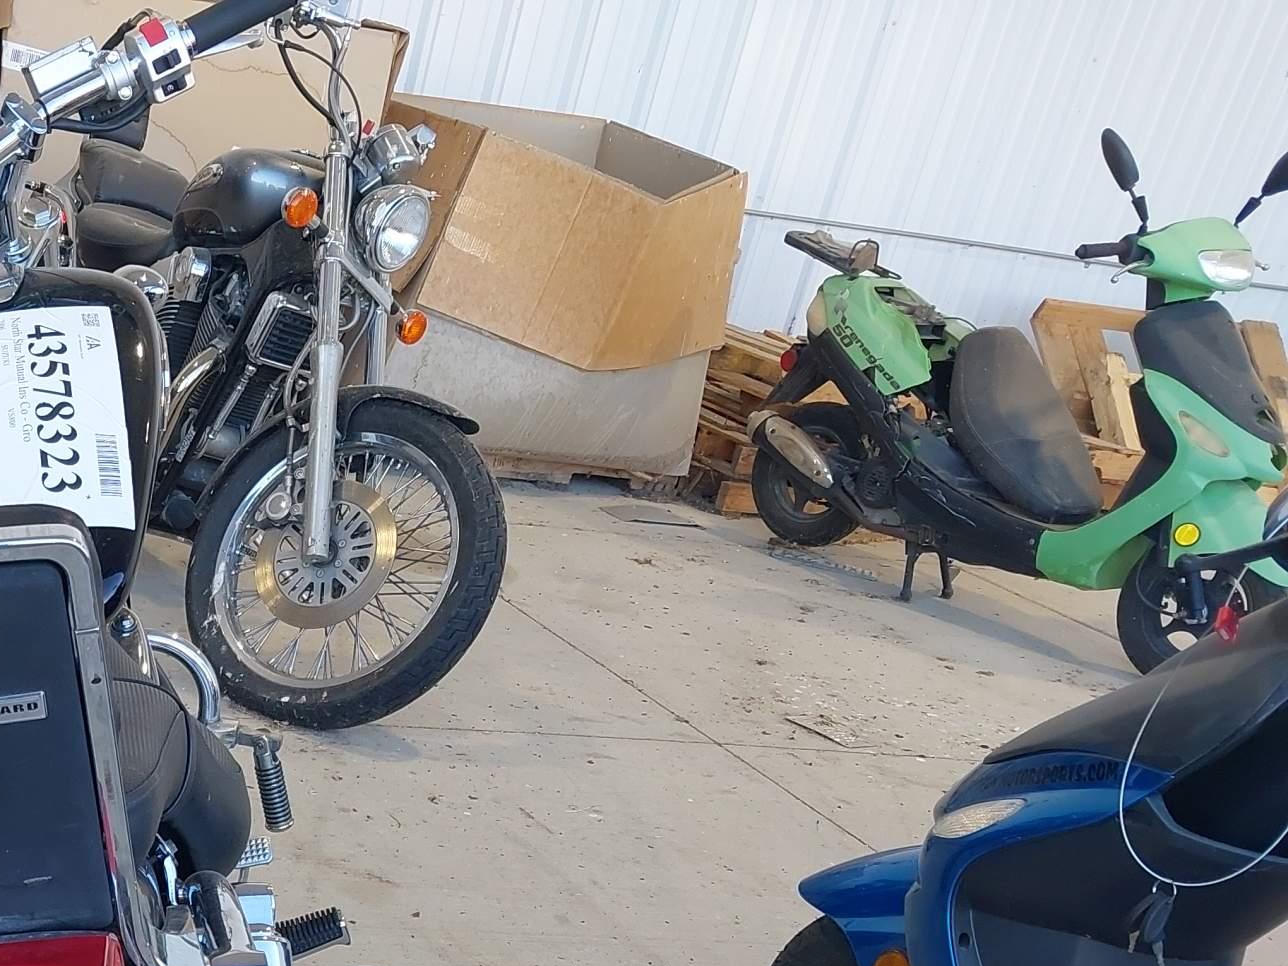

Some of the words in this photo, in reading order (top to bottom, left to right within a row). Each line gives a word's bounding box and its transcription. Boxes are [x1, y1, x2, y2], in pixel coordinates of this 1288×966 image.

[10, 316, 23, 338] North
[833, 324, 853, 348] 50
[13, 338, 24, 353] Star
[15, 354, 29, 384] Mutual
[844, 325, 901, 391] renegade
[18, 386, 29, 400] Ins
[19, 401, 31, 415] Co
[26, 324, 83, 493] 43578323
[21, 424, 33, 443] Gro
